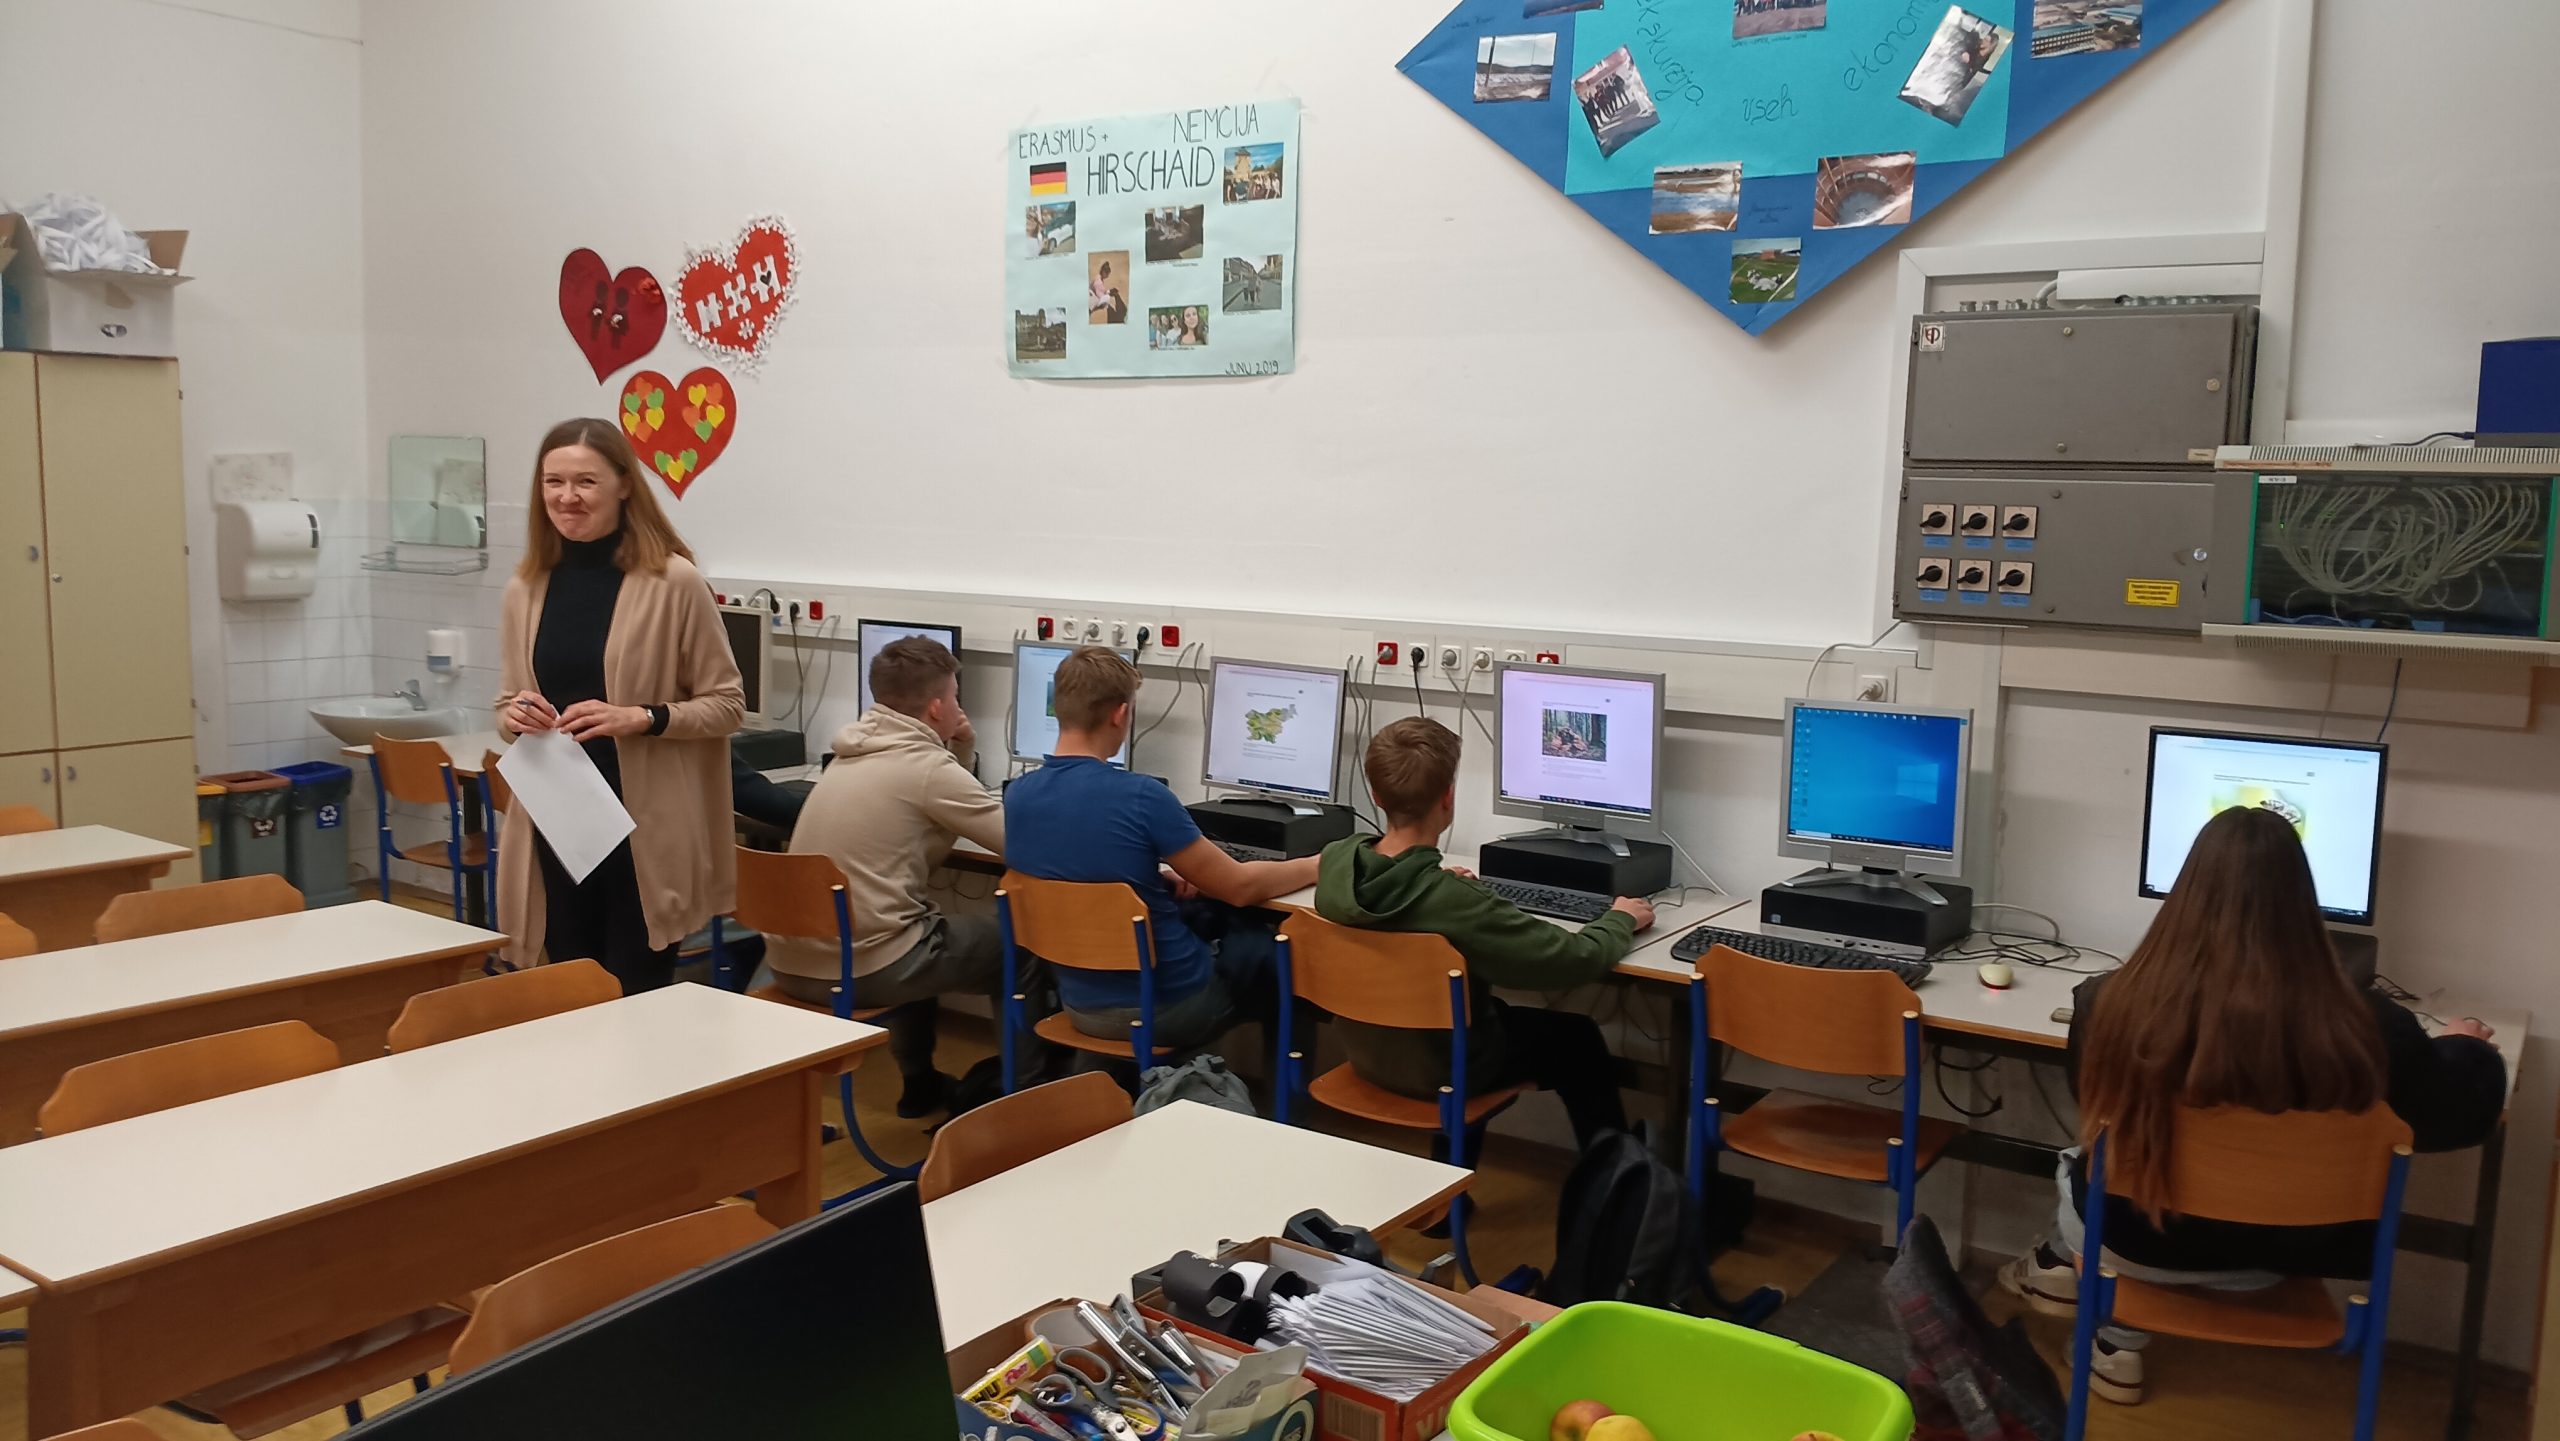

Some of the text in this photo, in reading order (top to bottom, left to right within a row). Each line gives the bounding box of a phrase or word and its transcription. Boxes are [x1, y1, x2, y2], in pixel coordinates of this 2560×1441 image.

[1742, 83, 1799, 126] vseh
[1843, 0, 1941, 91] ekonom
[1173, 103, 1259, 145] NEMČIJA
[1087, 146, 1216, 197] HIRSCHAID
[1255, 359, 1279, 376] 2019
